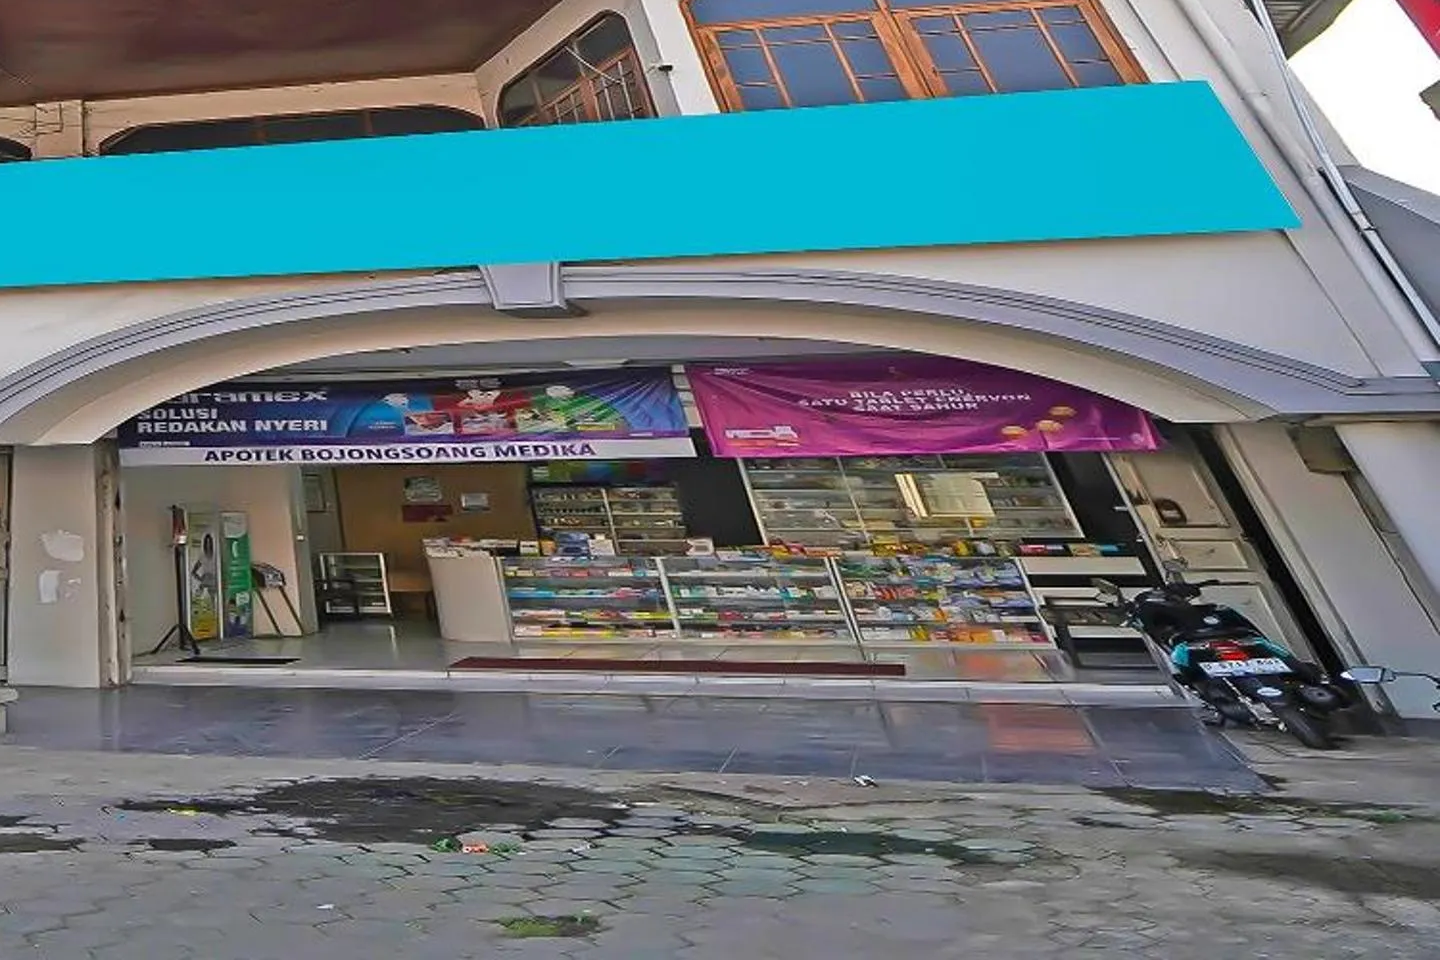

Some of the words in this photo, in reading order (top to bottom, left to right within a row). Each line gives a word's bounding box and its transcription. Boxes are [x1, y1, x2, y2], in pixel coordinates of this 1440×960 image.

[138, 408, 218, 420] SOLUSI
[137, 419, 247, 434] REDAKAN
[254, 419, 328, 432] NYERI
[204, 448, 294, 463] APOTEK
[300, 444, 487, 461] BOJONGSOANG
[492, 442, 597, 458] MEDIKA
